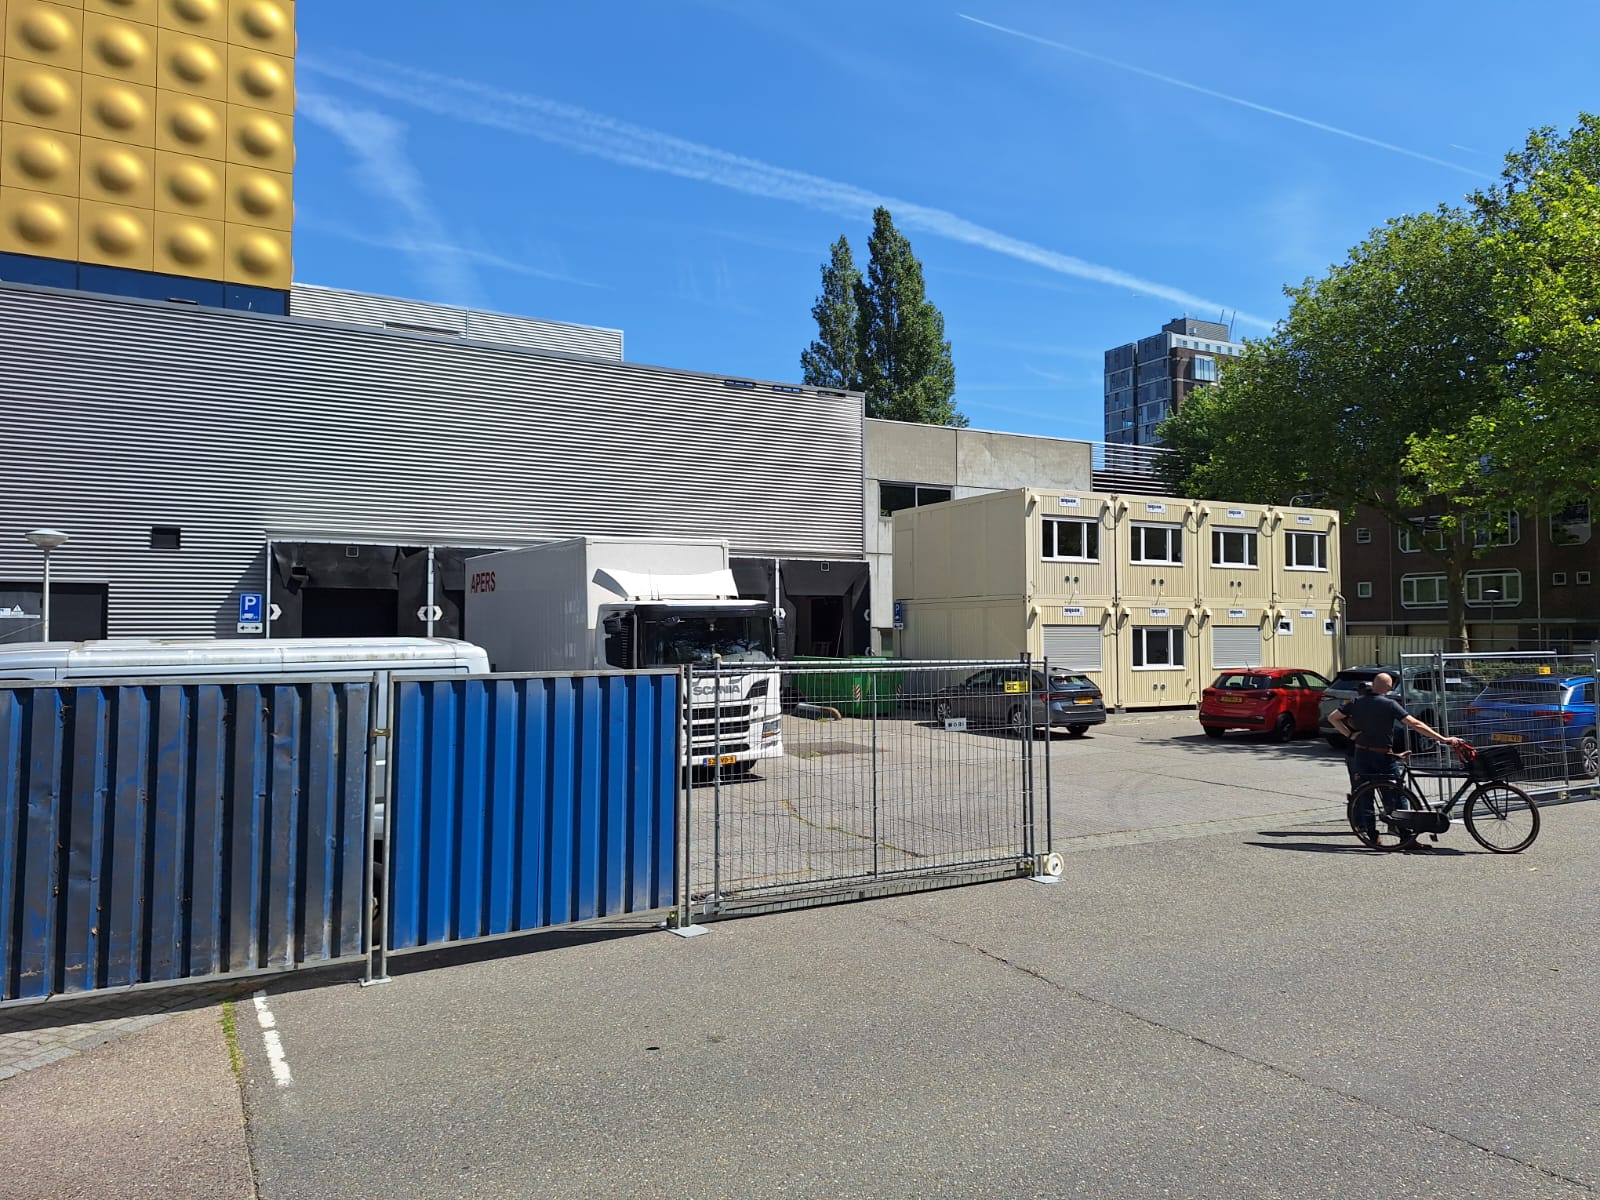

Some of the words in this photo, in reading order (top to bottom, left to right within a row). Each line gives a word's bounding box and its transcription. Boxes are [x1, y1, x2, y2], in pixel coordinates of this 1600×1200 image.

[471, 571, 496, 593] APERS
[244, 596, 257, 611] P
[693, 684, 740, 696] SCANIA
